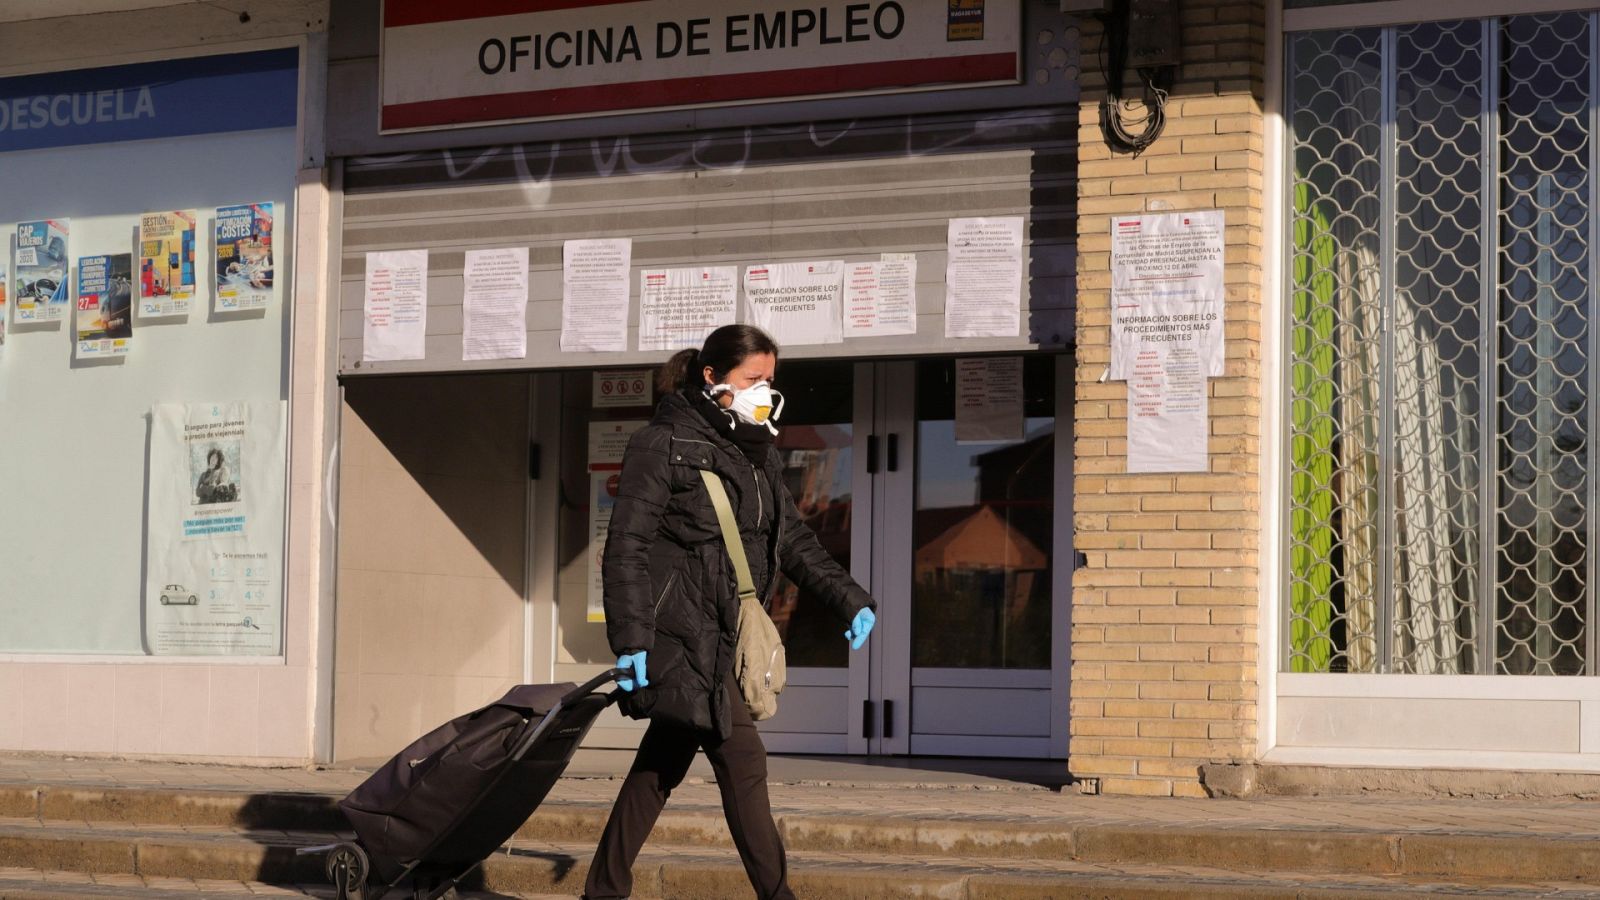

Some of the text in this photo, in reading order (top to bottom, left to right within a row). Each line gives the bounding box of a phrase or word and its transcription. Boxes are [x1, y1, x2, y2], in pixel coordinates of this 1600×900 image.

[478, 1, 905, 75] OFICINA DE EMPLEO
[19, 225, 33, 237] CAP
[222, 224, 250, 238] COSTES
[19, 237, 43, 246] VIAJEROS
[1171, 242, 1191, 250] Empleo
[20, 254, 33, 263] 2020
[798, 285, 822, 294] SOBRE
[824, 284, 838, 292] LOS
[754, 293, 832, 304] PROCEDIMIENTOS MÁS
[80, 297, 89, 310] 27
[770, 304, 815, 312] FRECUENTES
[1172, 313, 1199, 322] SOBRE
[1201, 312, 1217, 321] LOS
[1123, 324, 1192, 333] PROCEDIMIENTOS
[1140, 334, 1192, 342] FRECUENTES
[211, 568, 215, 576] 1
[246, 568, 252, 577] 2
[209, 590, 216, 599] 3
[244, 591, 251, 600] 4
